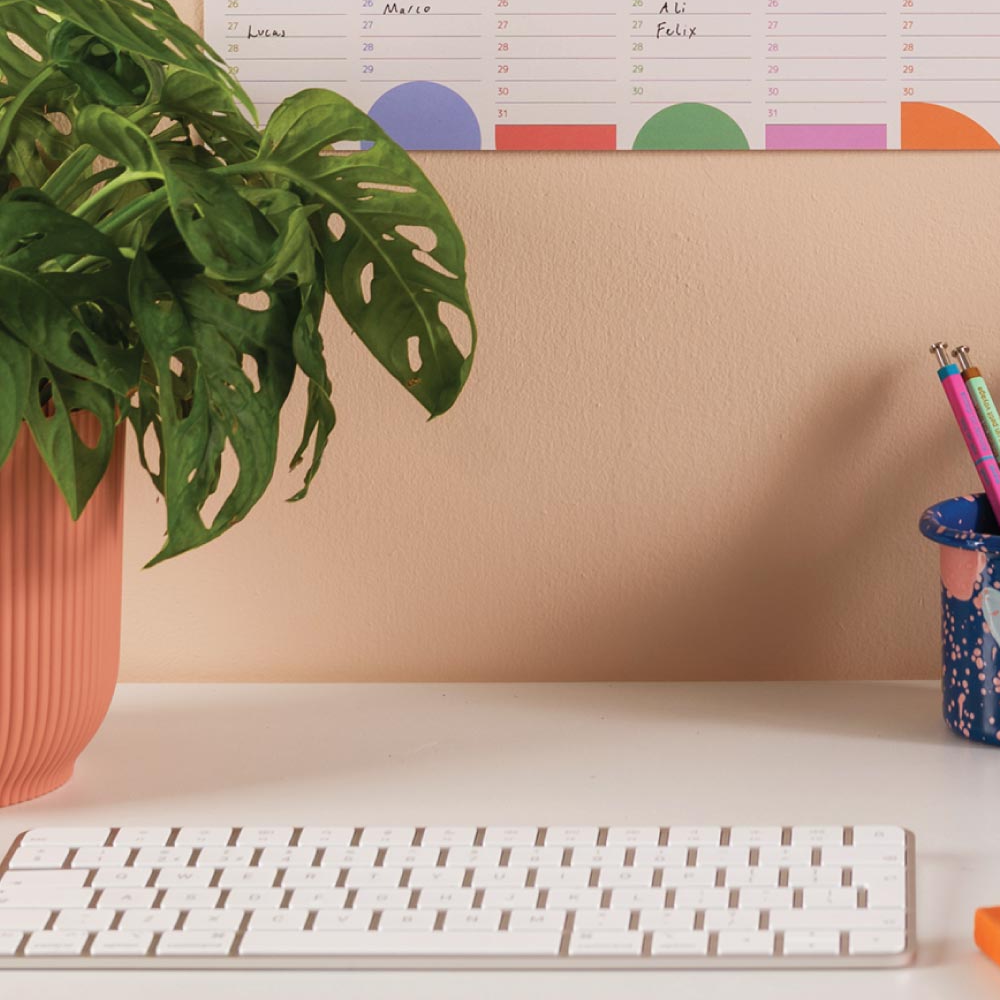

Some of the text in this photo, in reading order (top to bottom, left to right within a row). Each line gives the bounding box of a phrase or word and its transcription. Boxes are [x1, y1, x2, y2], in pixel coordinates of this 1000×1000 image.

[383, 2, 431, 15] Marco
[659, 1, 686, 15] Ali
[227, 21, 239, 31] 27
[631, 20, 644, 30] 27
[656, 21, 697, 39] Felix
[247, 25, 286, 40] Lucas
[498, 108, 508, 119] 31
[768, 108, 778, 118] 31
